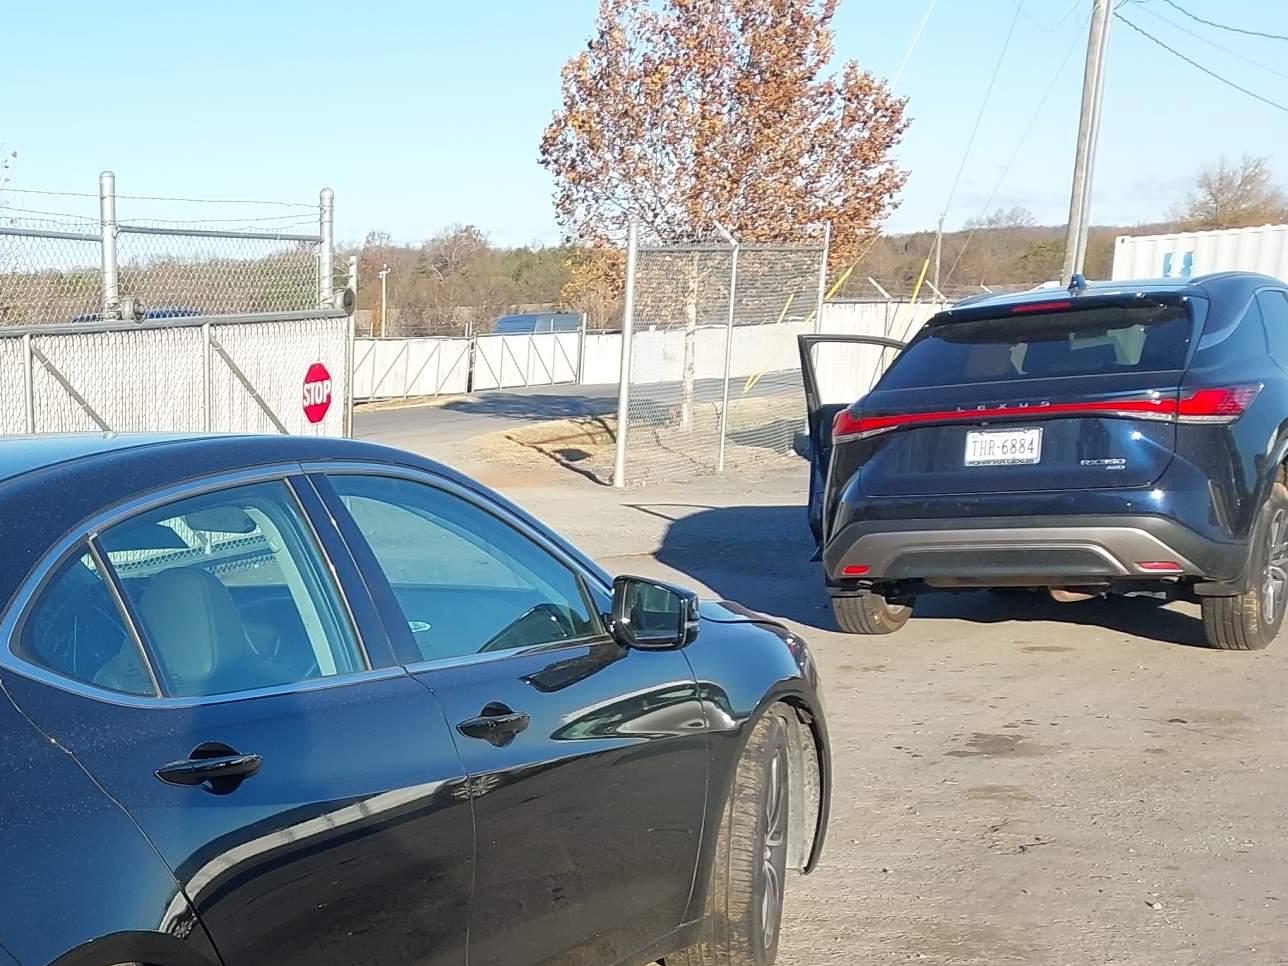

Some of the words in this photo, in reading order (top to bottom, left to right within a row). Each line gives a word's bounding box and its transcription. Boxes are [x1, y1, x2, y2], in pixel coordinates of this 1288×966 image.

[304, 380, 331, 406] STOP
[957, 401, 1050, 412] LEXUS
[972, 437, 1034, 457] THR-6884
